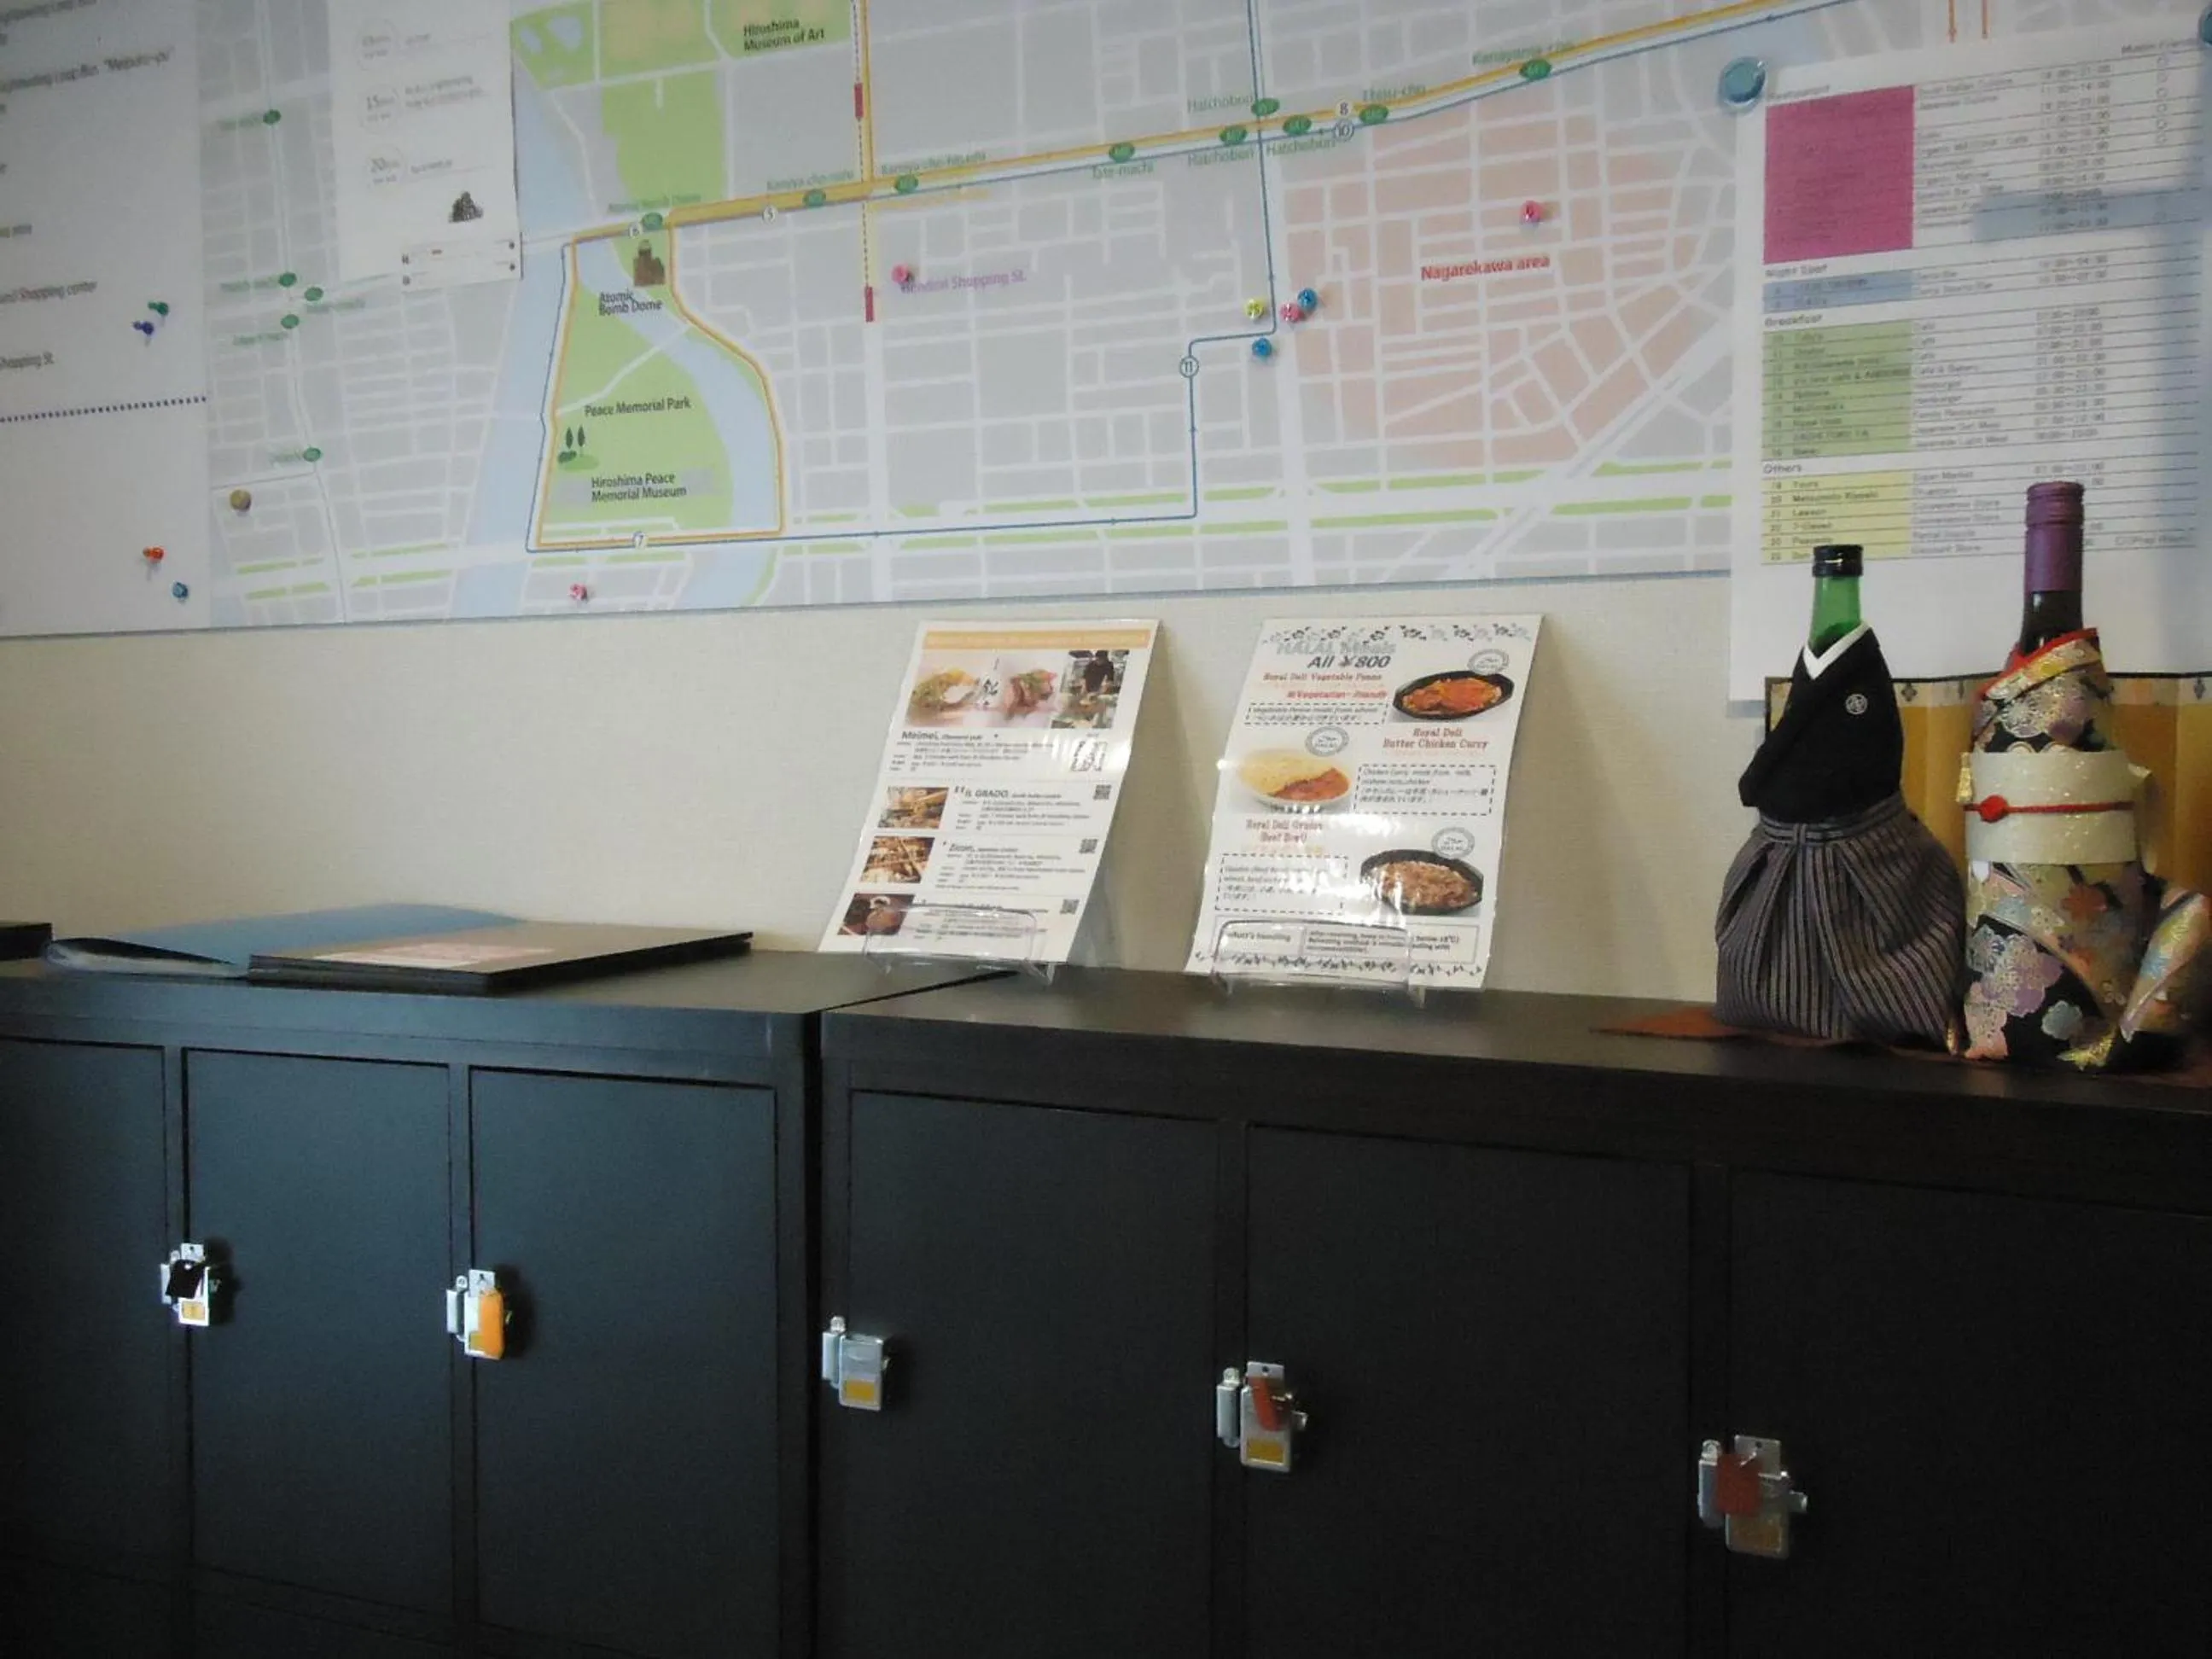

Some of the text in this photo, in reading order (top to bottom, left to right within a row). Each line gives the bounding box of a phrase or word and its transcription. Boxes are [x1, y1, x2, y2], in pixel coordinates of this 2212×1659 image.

[1517, 254, 1551, 269] area
[584, 395, 692, 416] Peace Memorial Park
[591, 472, 676, 489] Hiroshima Peace
[591, 485, 688, 504] Memorial Museum
[1307, 655, 1335, 669] All
